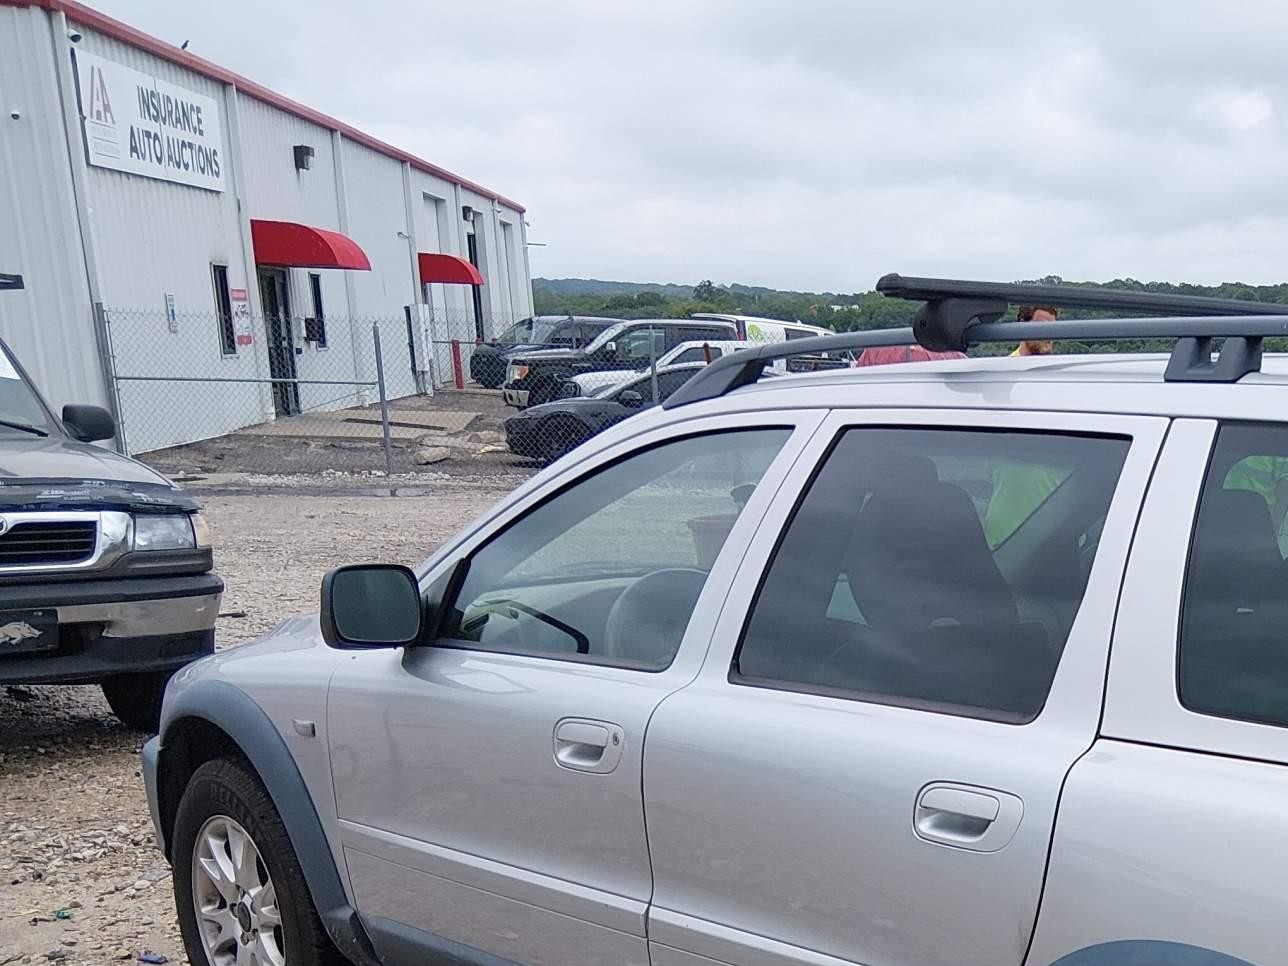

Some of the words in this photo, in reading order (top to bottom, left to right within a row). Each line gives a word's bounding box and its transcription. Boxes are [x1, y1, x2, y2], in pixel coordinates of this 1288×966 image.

[136, 84, 204, 137] INSURANCE
[129, 124, 164, 166] AUTO
[166, 135, 220, 179] AUCTIONS
